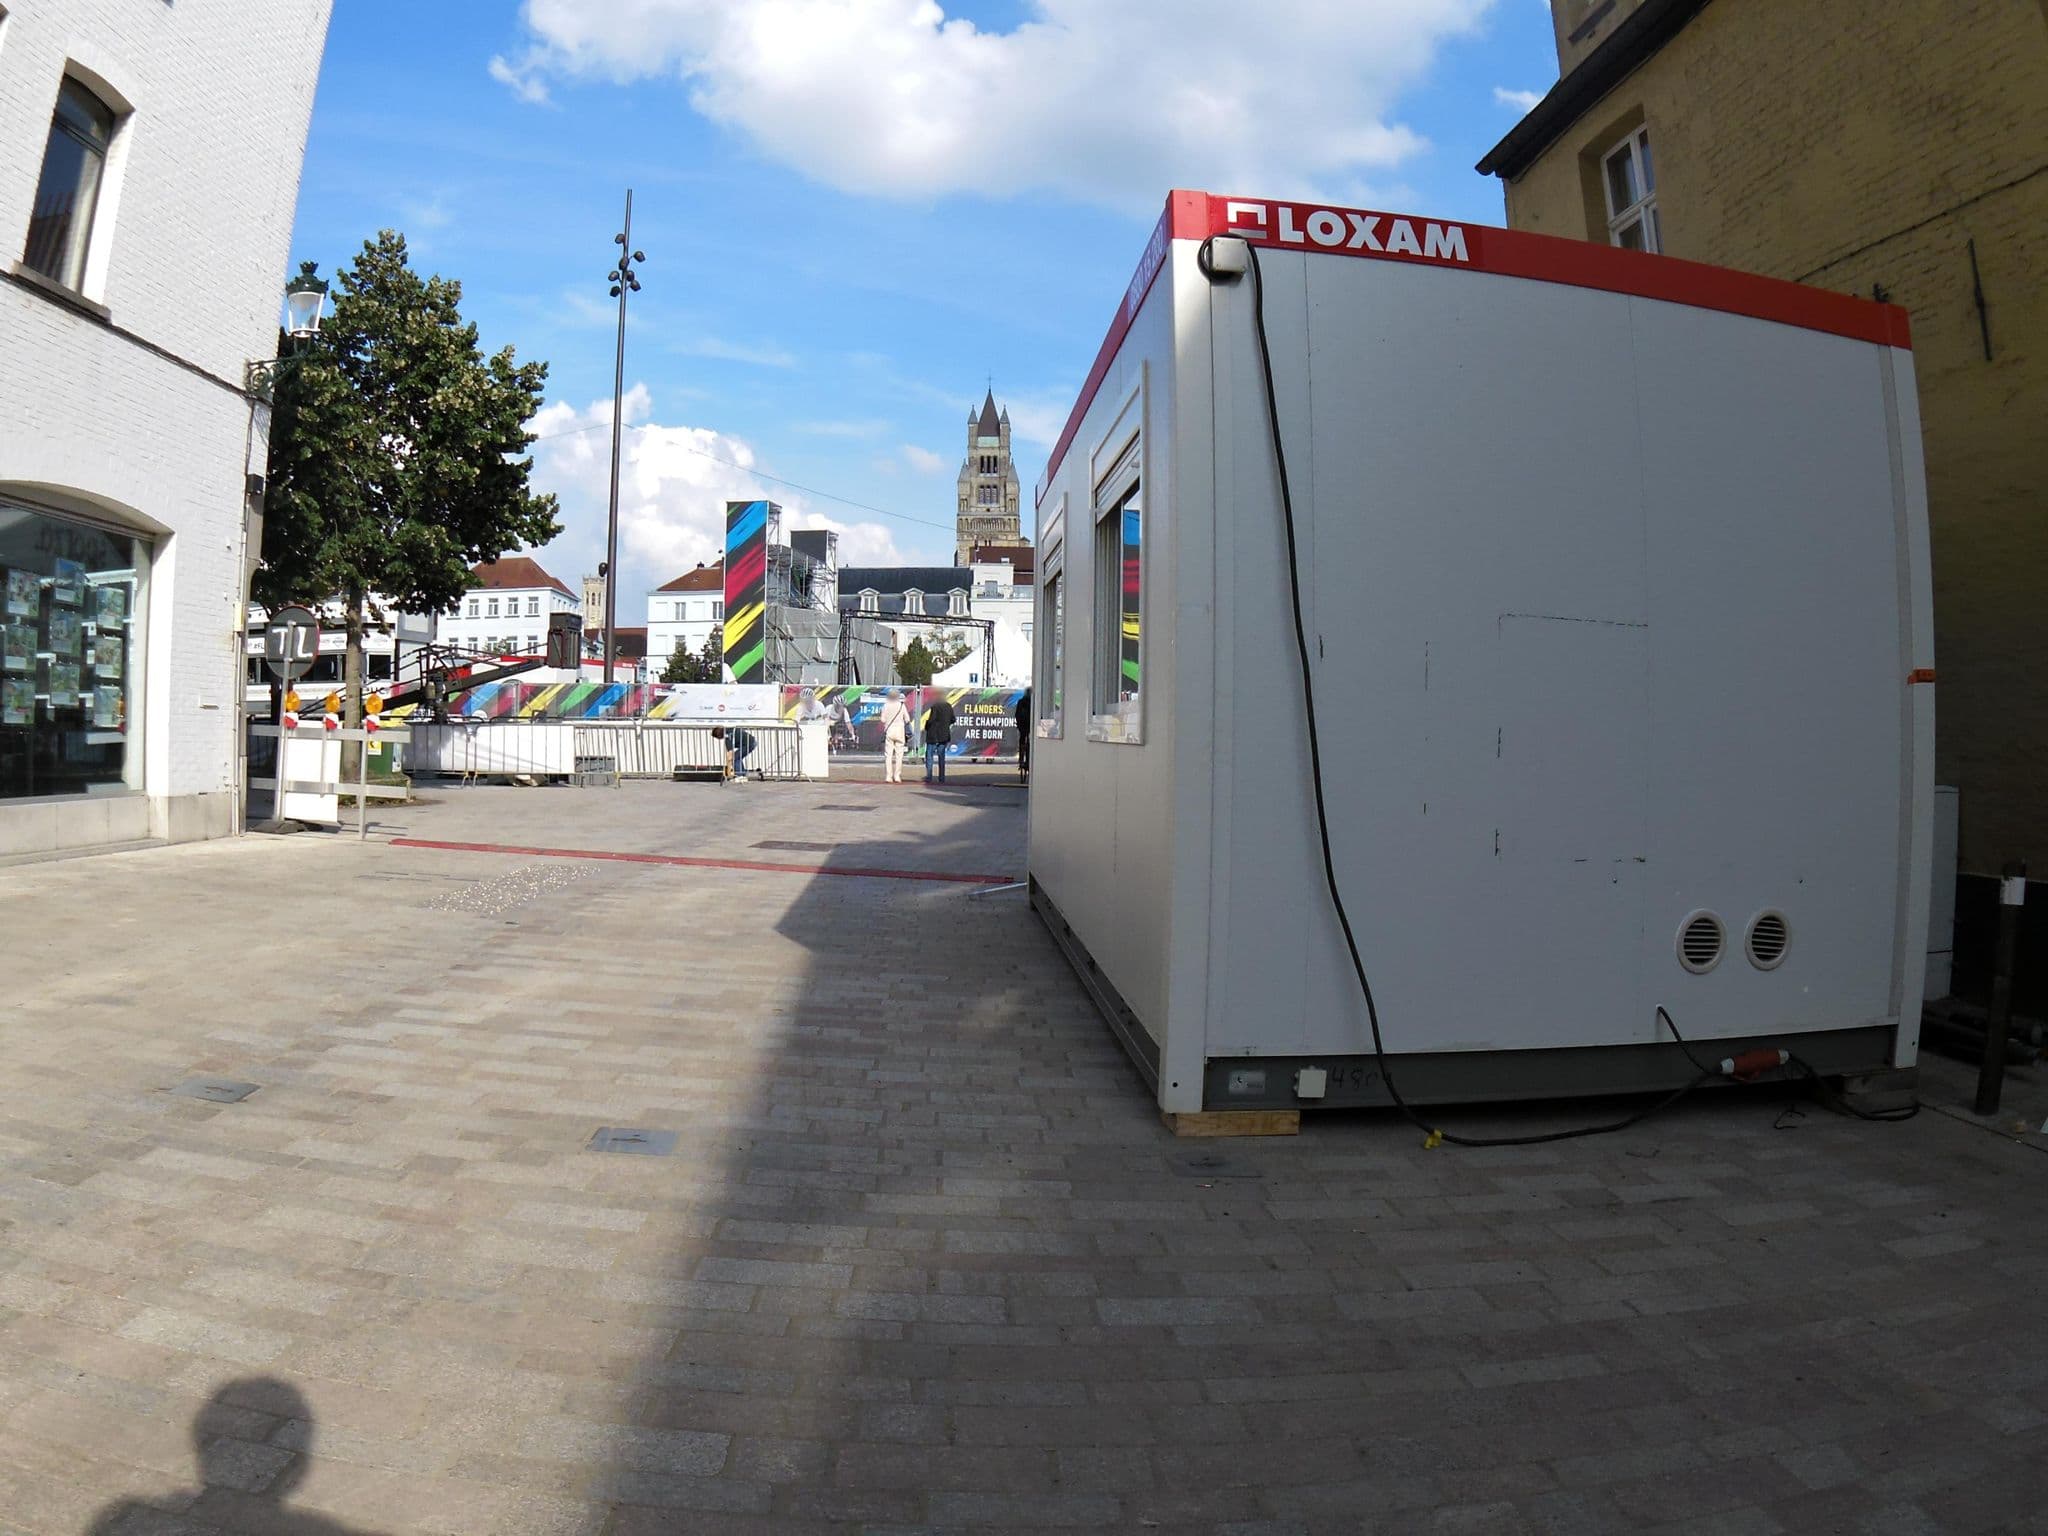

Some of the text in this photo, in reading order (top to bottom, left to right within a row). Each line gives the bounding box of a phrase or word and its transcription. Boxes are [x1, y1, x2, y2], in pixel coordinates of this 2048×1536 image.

[1278, 206, 1469, 262] LOXAM
[954, 716, 973, 727] HERE
[965, 729, 1003, 740] ARE BORN
